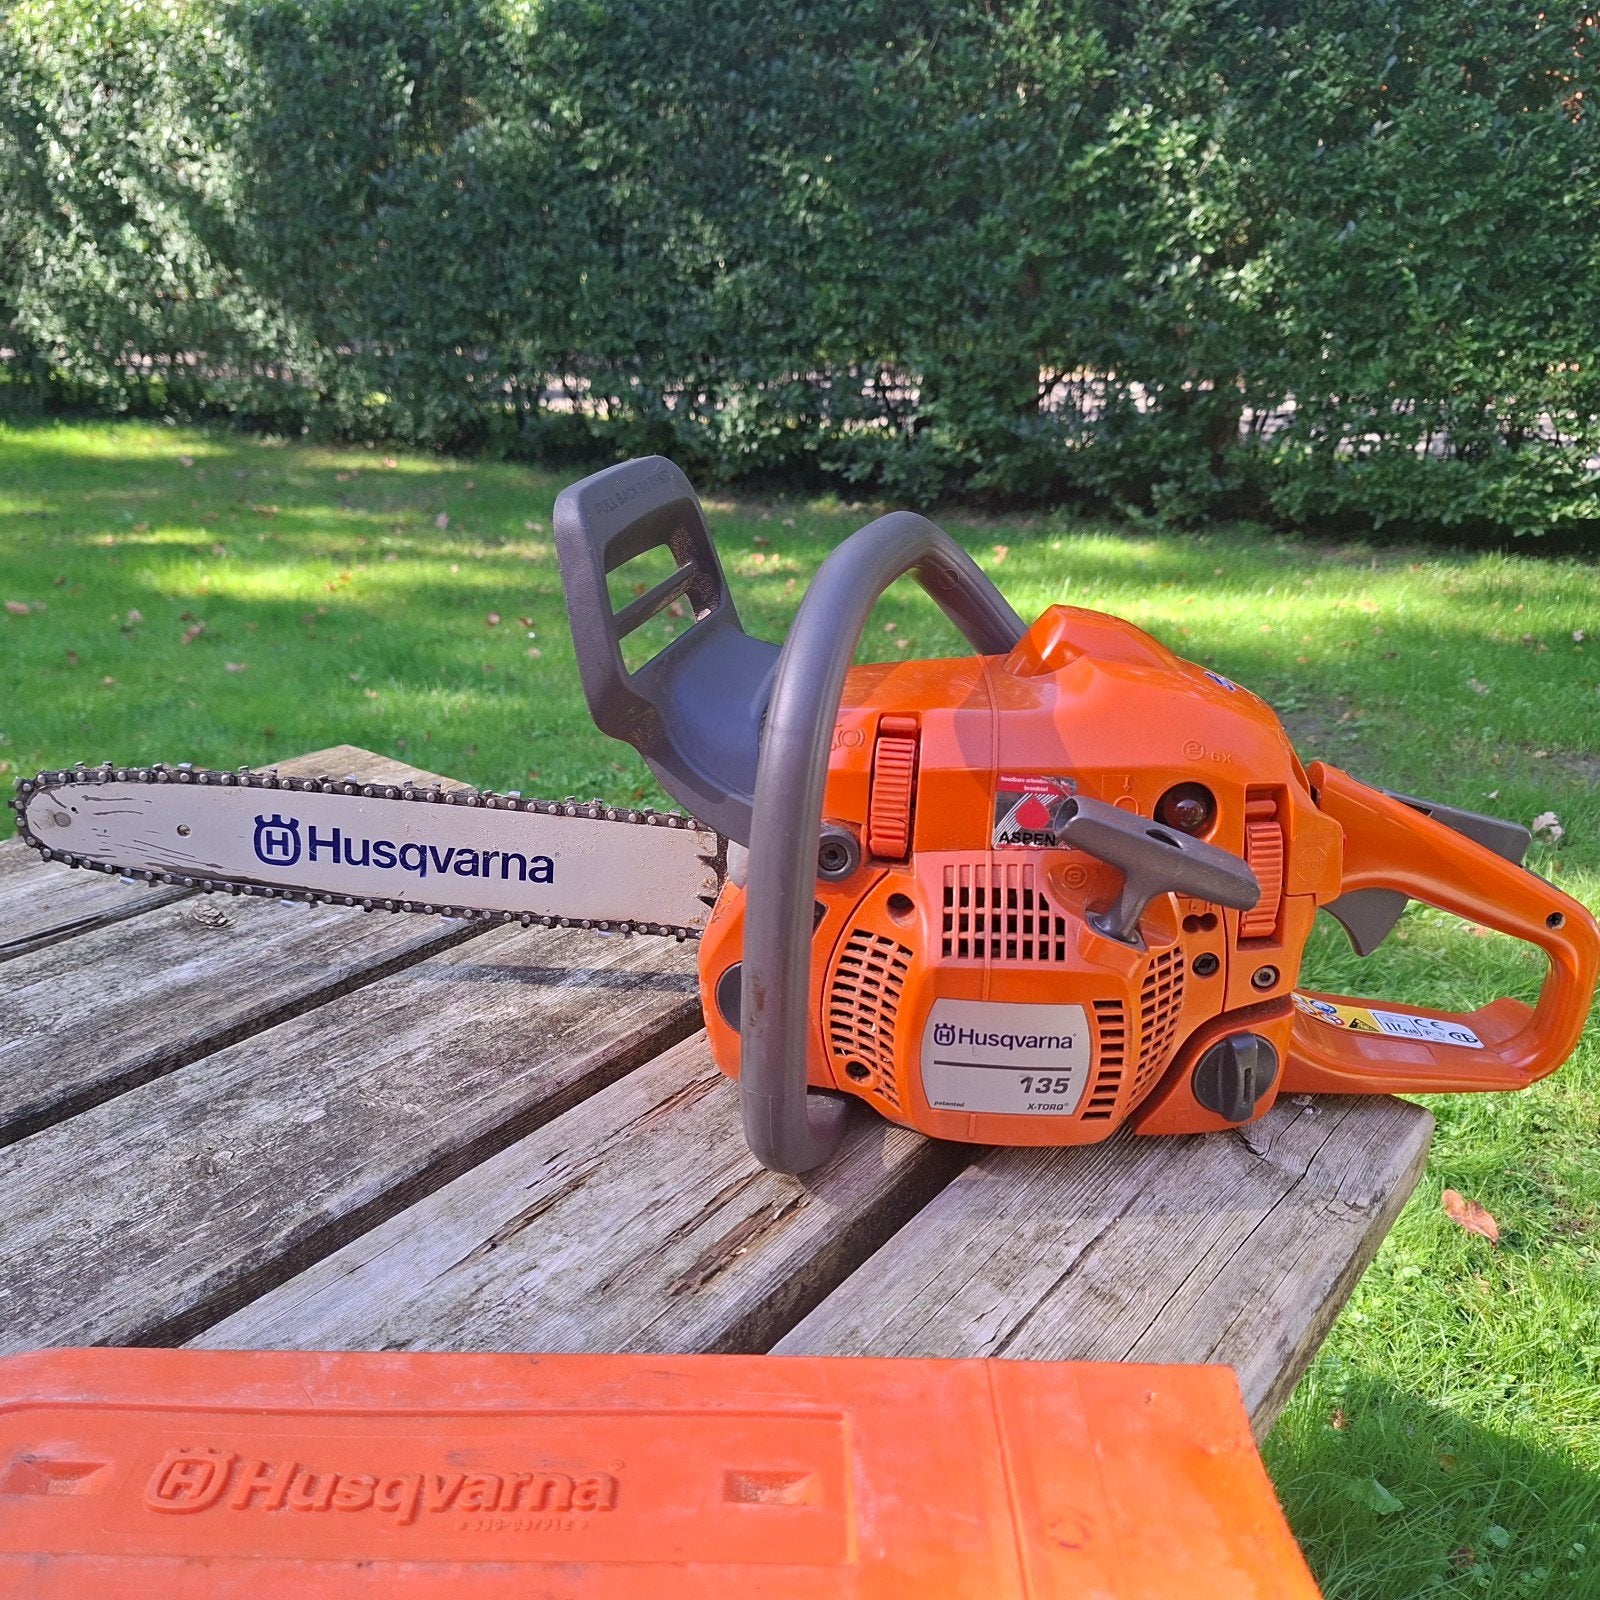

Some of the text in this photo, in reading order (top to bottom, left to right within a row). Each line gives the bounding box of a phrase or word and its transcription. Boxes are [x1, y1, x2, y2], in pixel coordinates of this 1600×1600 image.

[999, 831, 1056, 847] ASPEN
[308, 824, 555, 884] Husqvarna
[958, 1028, 1073, 1051] Husqvarna
[1020, 1076, 1070, 1094] 135
[933, 1100, 965, 1108] patented
[229, 1456, 619, 1527] Husqvarna
